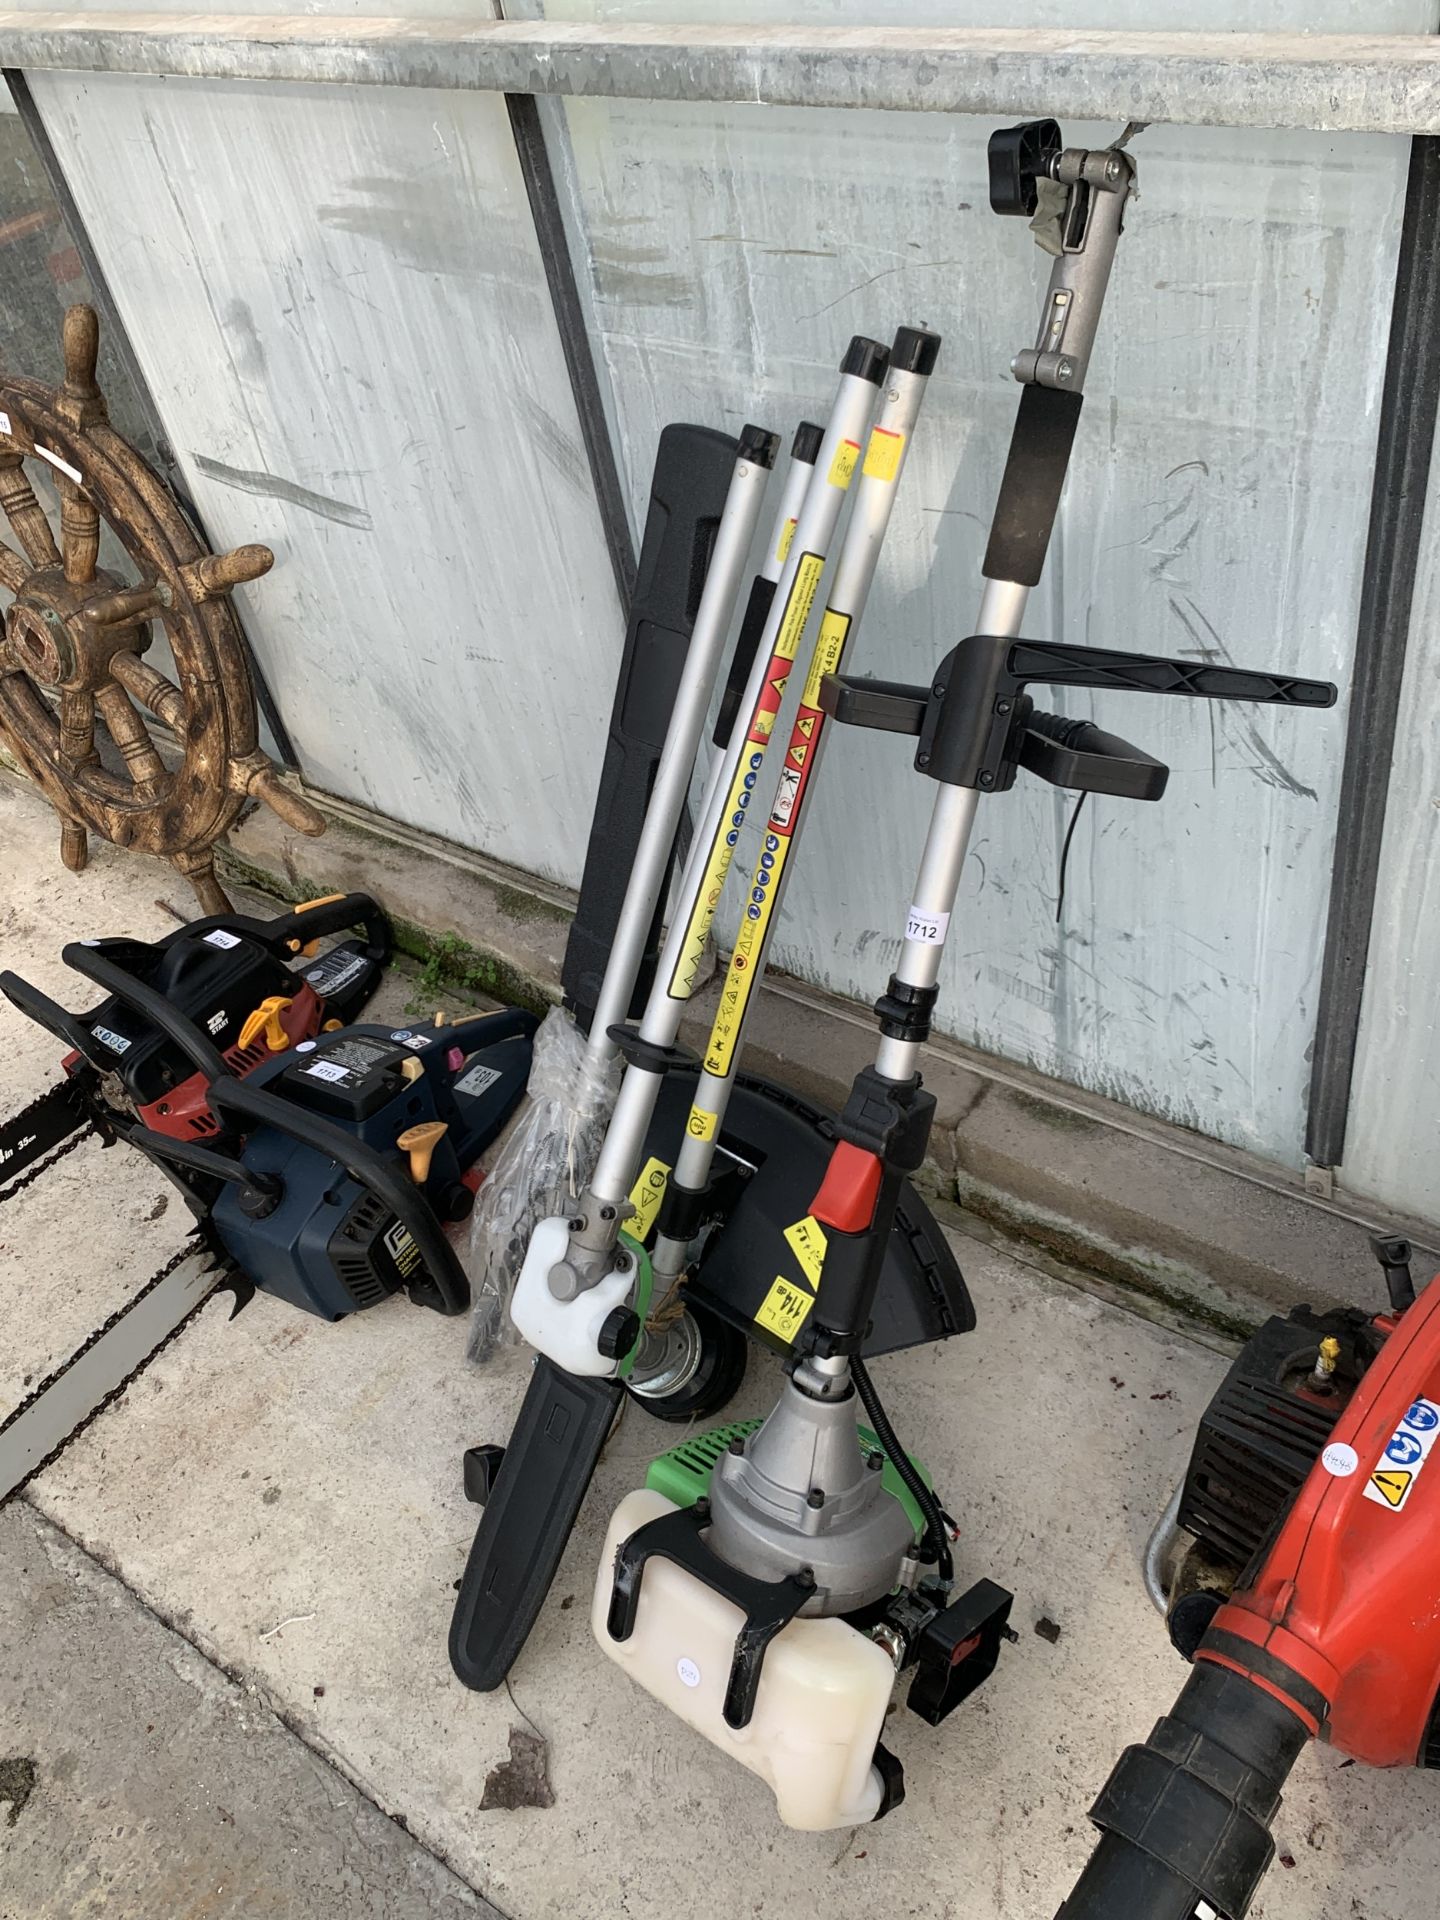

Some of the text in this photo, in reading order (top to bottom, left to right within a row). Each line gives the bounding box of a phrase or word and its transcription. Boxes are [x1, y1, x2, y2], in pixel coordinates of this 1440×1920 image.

[826, 636, 840, 659] B2-2
[908, 921, 937, 938] 1712
[317, 1068, 337, 1078] 1713
[780, 1291, 805, 1319] 114
